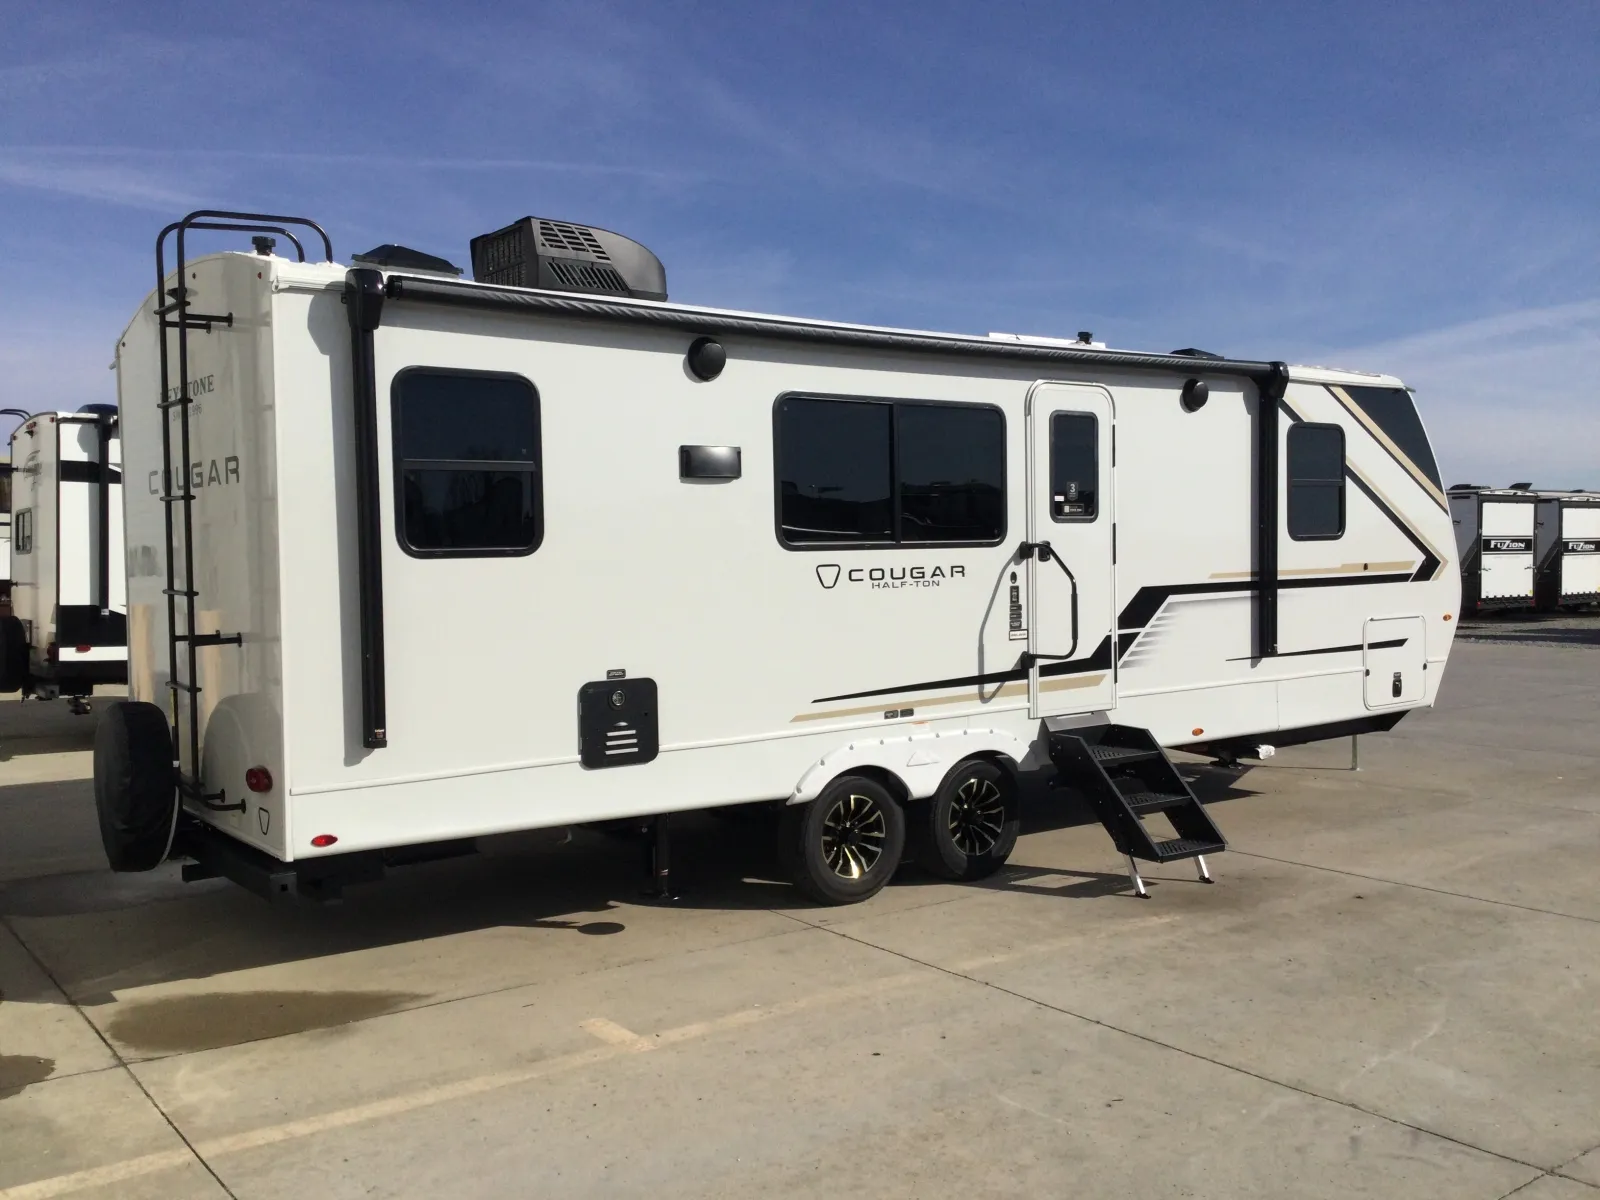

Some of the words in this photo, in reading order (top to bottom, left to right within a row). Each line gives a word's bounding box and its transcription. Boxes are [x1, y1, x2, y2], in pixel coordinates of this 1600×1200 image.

[1069, 483, 1076, 493] 3
[1490, 540, 1526, 550] FUZION
[848, 565, 966, 582] COUGAR
[871, 580, 940, 589] HALF-TON
